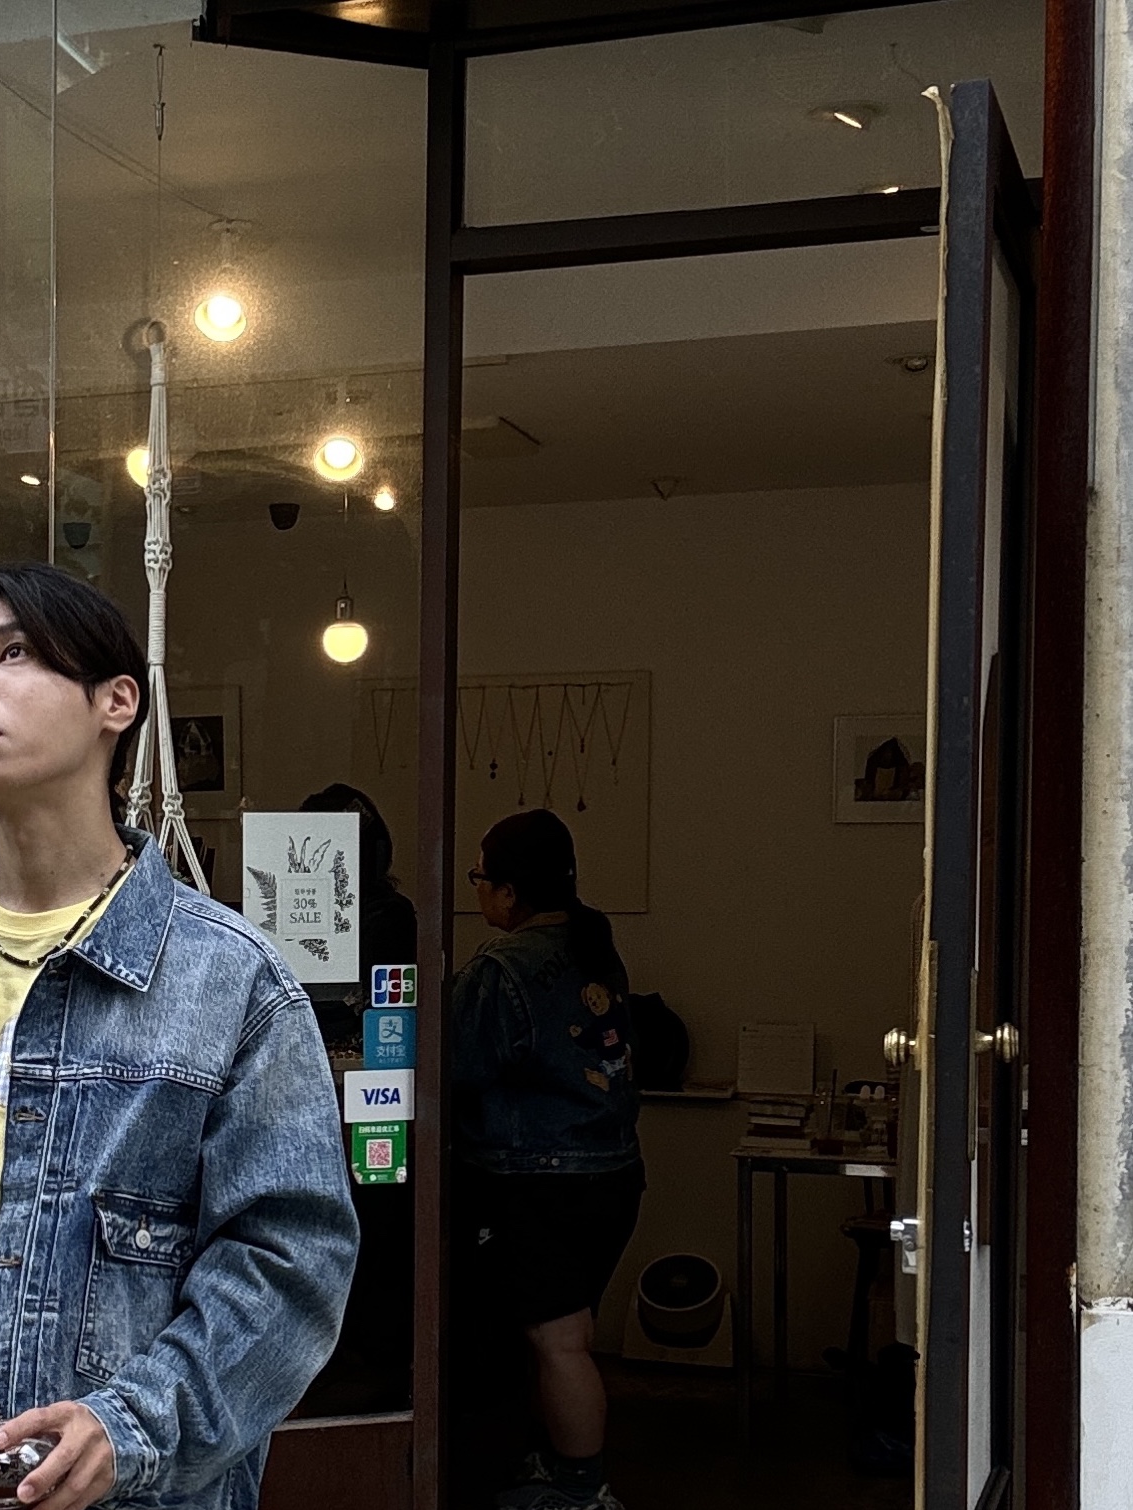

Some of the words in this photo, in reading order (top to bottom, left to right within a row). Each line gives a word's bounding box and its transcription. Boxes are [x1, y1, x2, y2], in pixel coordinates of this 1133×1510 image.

[293, 898, 317, 910] 30%
[289, 911, 322, 924] SALE
[374, 979, 414, 993] JCB
[375, 1044, 406, 1058] 支付宝
[360, 1087, 401, 1105] VISA
